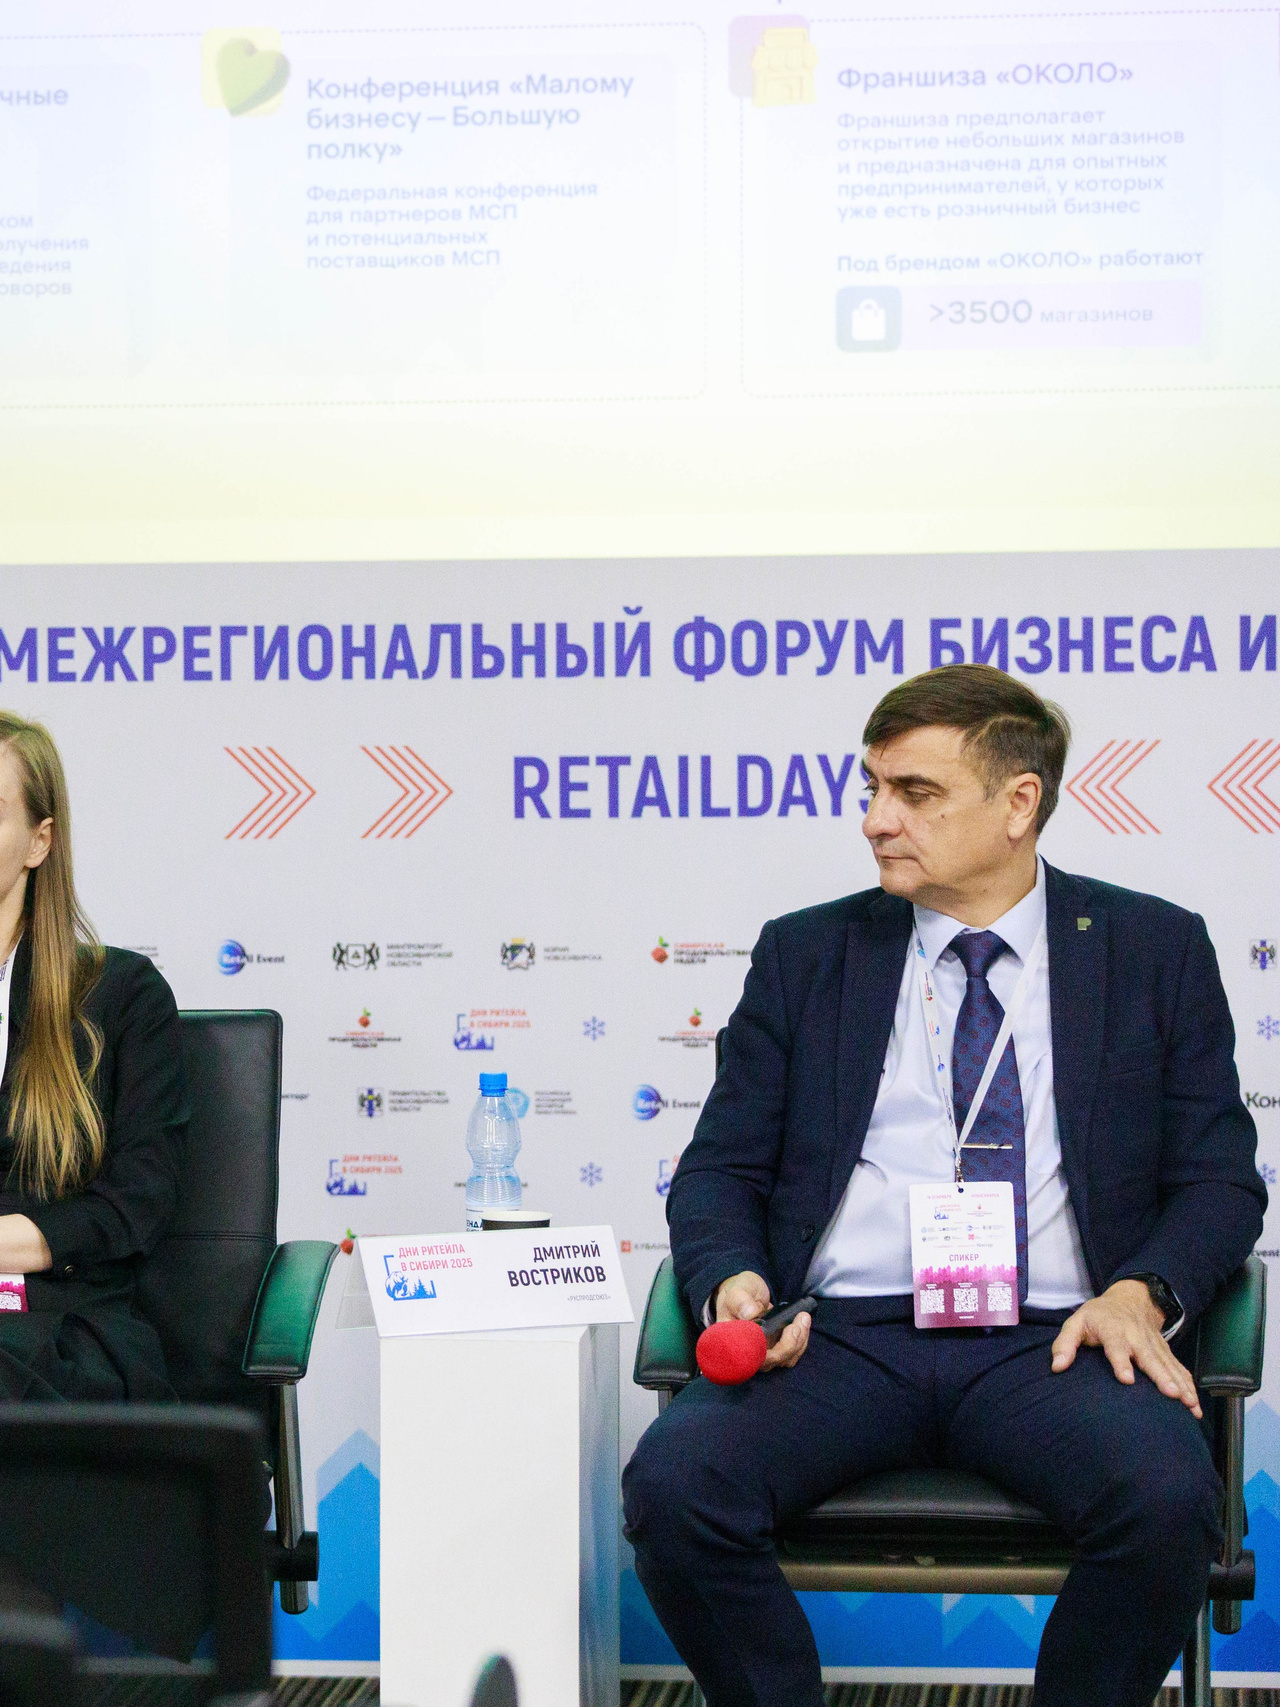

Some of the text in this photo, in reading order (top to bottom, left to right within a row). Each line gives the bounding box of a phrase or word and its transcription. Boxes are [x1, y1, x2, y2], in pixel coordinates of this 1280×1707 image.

[308, 74, 634, 102] Конференция «Малому
[837, 62, 1133, 94] Франшиза «ОКОЛО»
[306, 107, 421, 133] бизнесу
[452, 106, 580, 130] Большую
[837, 110, 1105, 132] Франшиза предполагает
[307, 142, 403, 162] полку»
[838, 130, 1185, 153] открытие небольших магазинов
[838, 155, 1167, 178] и предназначена для опытных
[306, 182, 598, 204] Федеральная конференция
[838, 177, 1164, 199] предпринимателей, у которых
[306, 203, 517, 226] для партнеров МСП
[837, 197, 1140, 222] уже есть розничный бизнес
[307, 232, 488, 247] и потенциальных
[307, 250, 500, 269] поставщиков МСП
[837, 248, 1204, 274] Под брендом «ОКОЛО» работают
[930, 299, 1153, 324] >3500 магазинов
[673, 615, 904, 682] ФОРУМ
[929, 615, 1217, 674] БИЗНЕСА
[1240, 615, 1276, 671] И
[398, 1243, 465, 1258] ДНИ РИТЕЙЛА
[534, 1241, 600, 1262] ДМИТРИЙ
[949, 1254, 979, 1262] СПИКЕР
[409, 1260, 448, 1271] СИБИРИ
[450, 1258, 473, 1268] 2025
[508, 1266, 606, 1287] ВОСТРИКОВ
